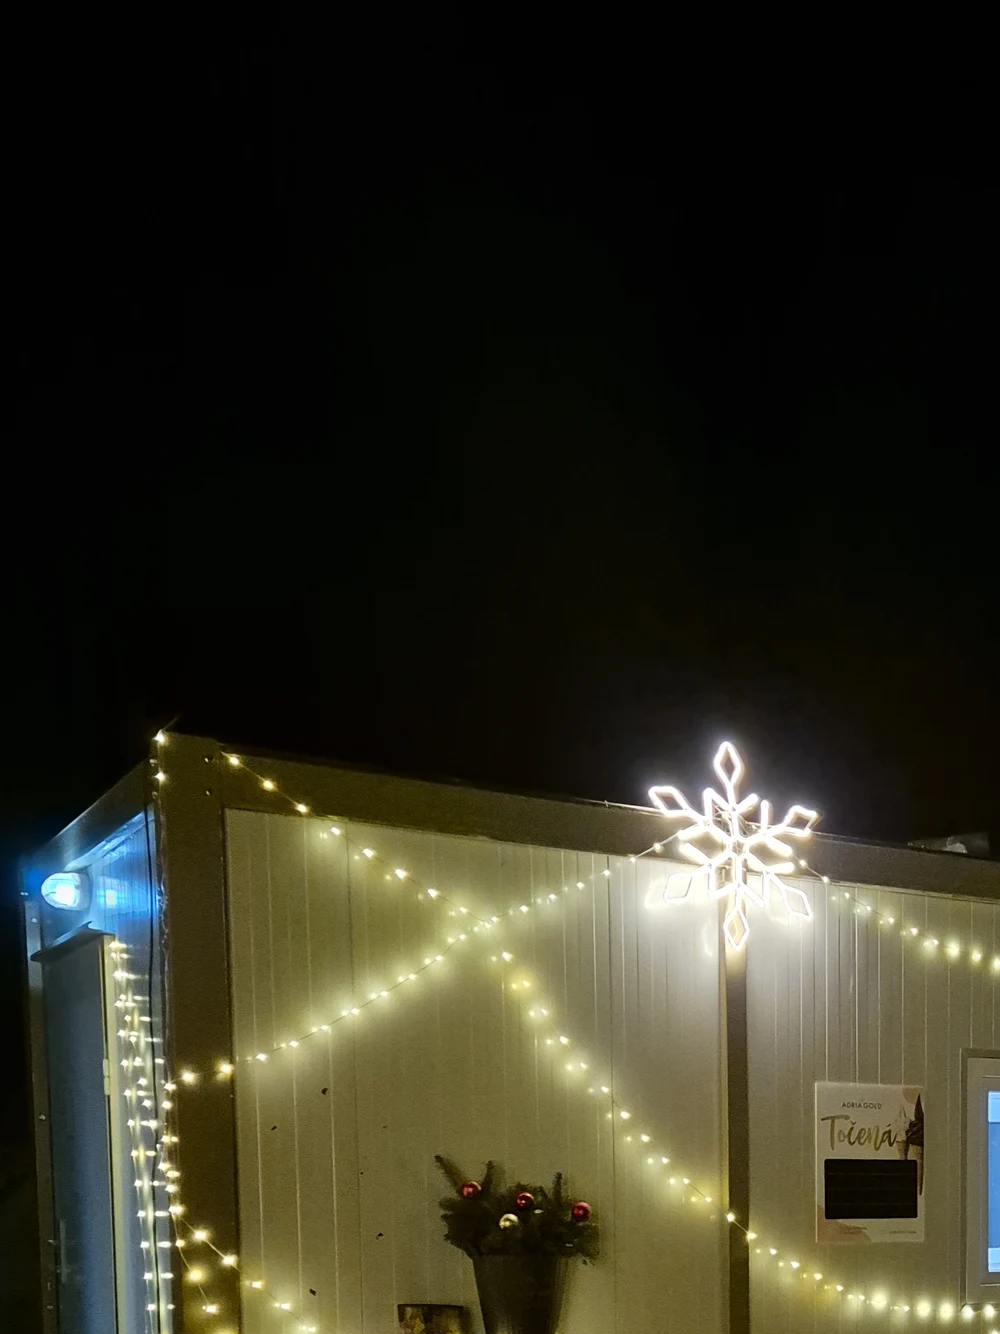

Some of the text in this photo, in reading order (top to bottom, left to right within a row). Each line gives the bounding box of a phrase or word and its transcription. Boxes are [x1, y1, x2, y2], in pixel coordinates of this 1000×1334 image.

[841, 1101, 882, 1110] ADRIA GOLD
[821, 1114, 897, 1151] Točená
